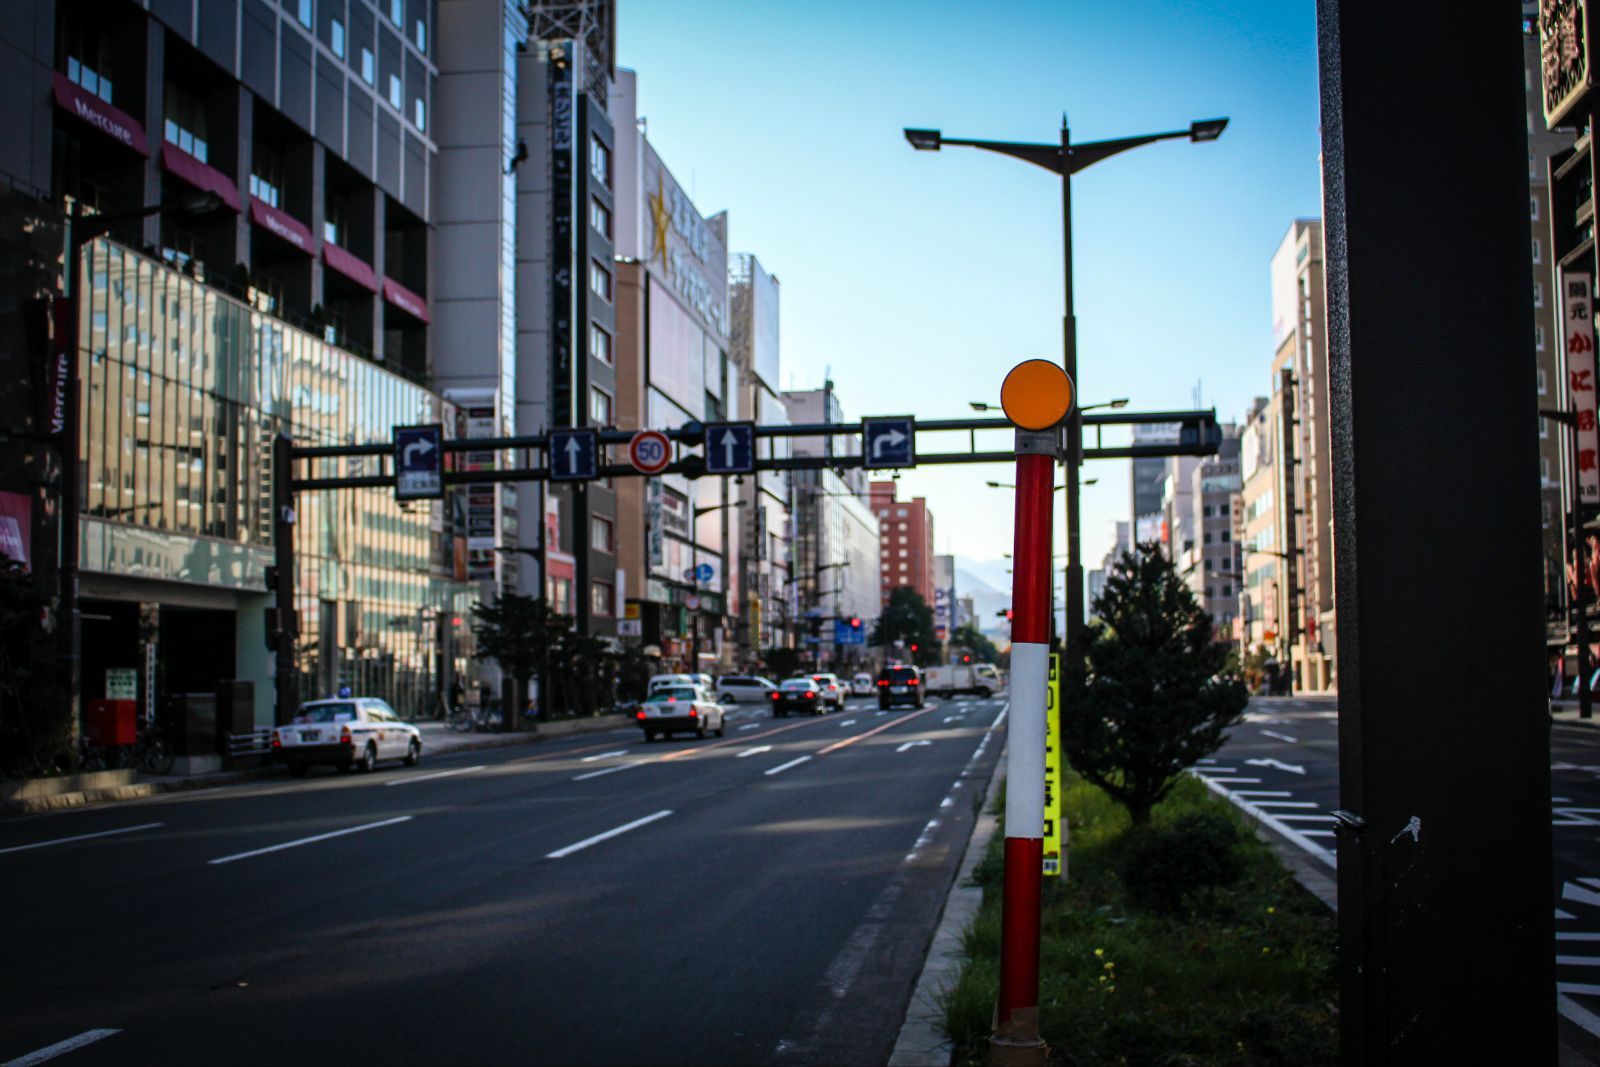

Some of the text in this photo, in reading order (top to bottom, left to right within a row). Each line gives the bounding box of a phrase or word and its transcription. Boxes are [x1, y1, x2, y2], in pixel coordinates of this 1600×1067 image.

[74, 97, 133, 146] Mercure
[51, 352, 69, 435] Mercure
[638, 441, 663, 461] 50
